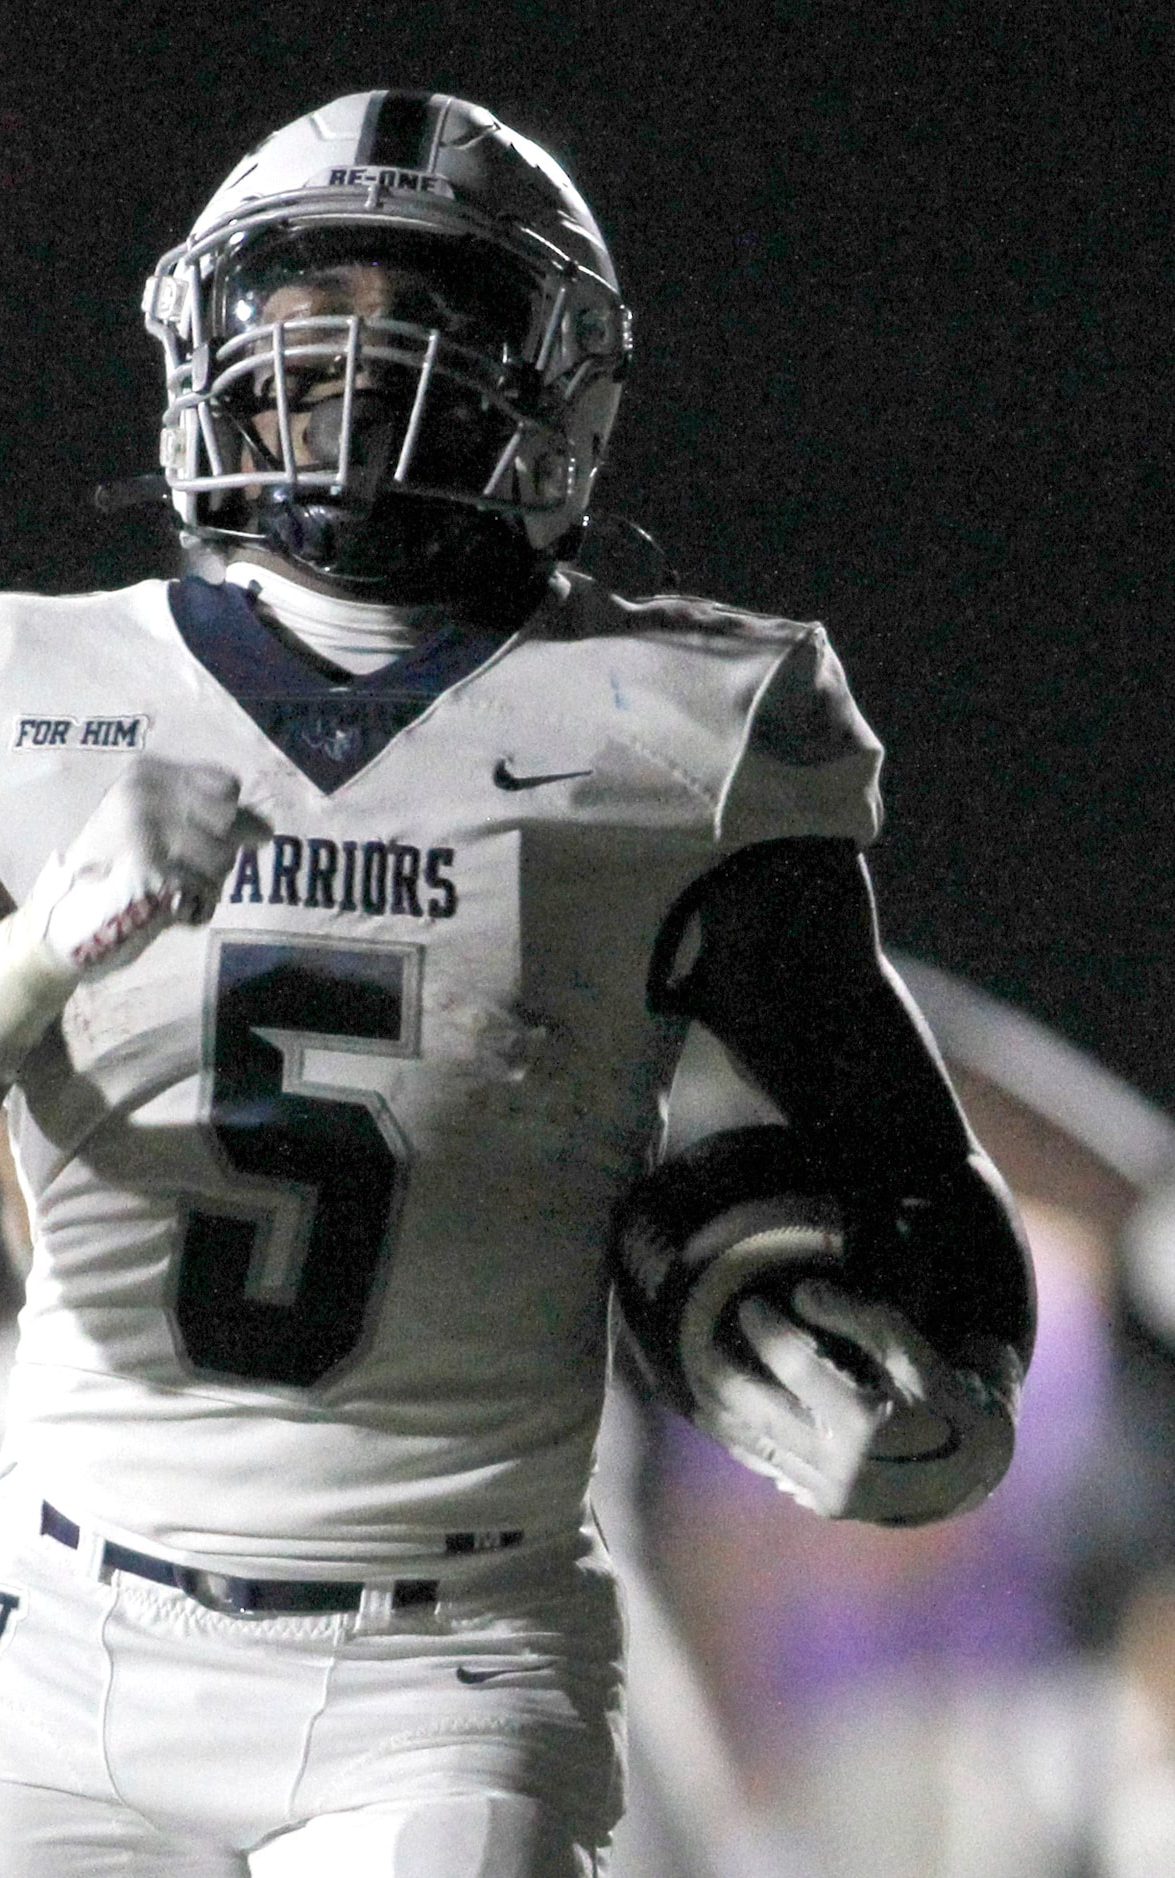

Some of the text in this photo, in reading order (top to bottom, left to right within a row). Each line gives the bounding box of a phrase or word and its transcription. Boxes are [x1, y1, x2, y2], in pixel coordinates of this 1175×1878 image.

[15, 718, 141, 748] FOR HIM
[229, 833, 458, 919] ARRIORS
[163, 928, 425, 1389] 5
